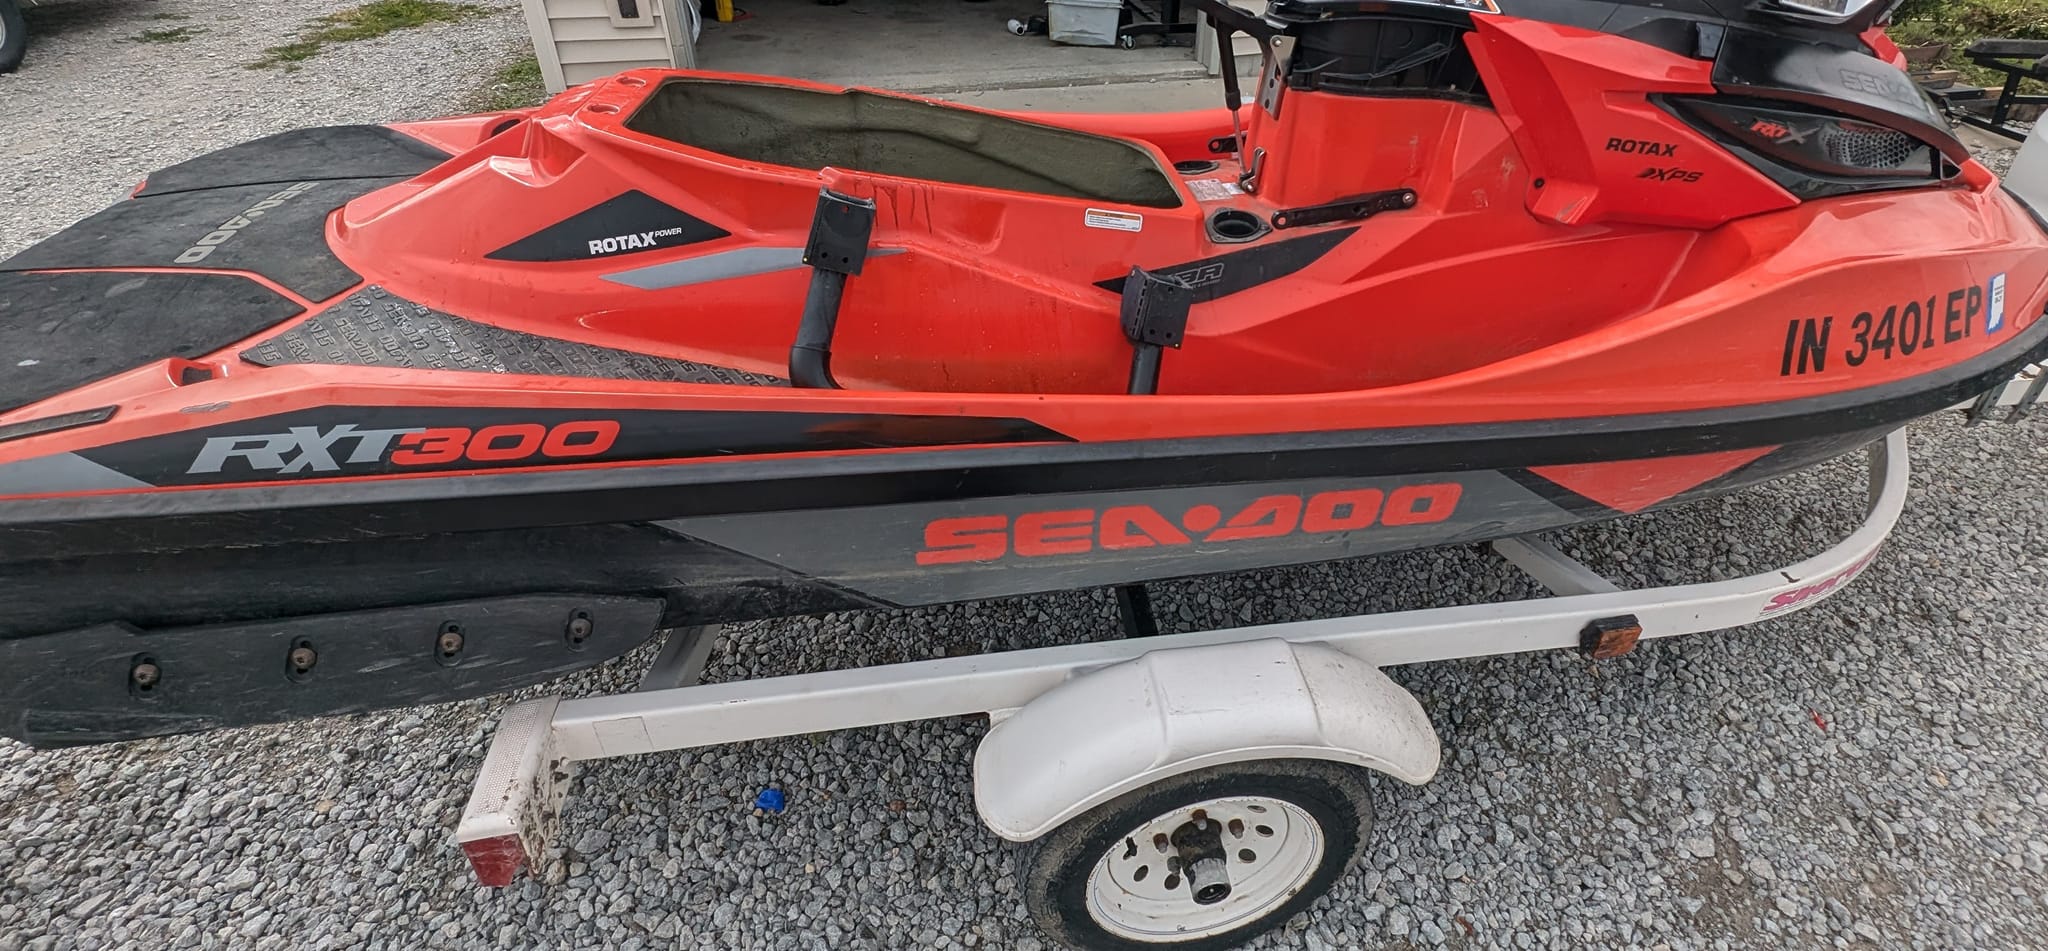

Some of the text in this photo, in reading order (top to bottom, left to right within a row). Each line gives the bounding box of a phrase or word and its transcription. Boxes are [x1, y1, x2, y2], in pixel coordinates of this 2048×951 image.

[1605, 138, 1678, 157] ROTAX
[1648, 167, 1704, 183] XPS
[588, 227, 683, 255] ROTAX POWER
[1780, 285, 1982, 377] IN 3401 EP
